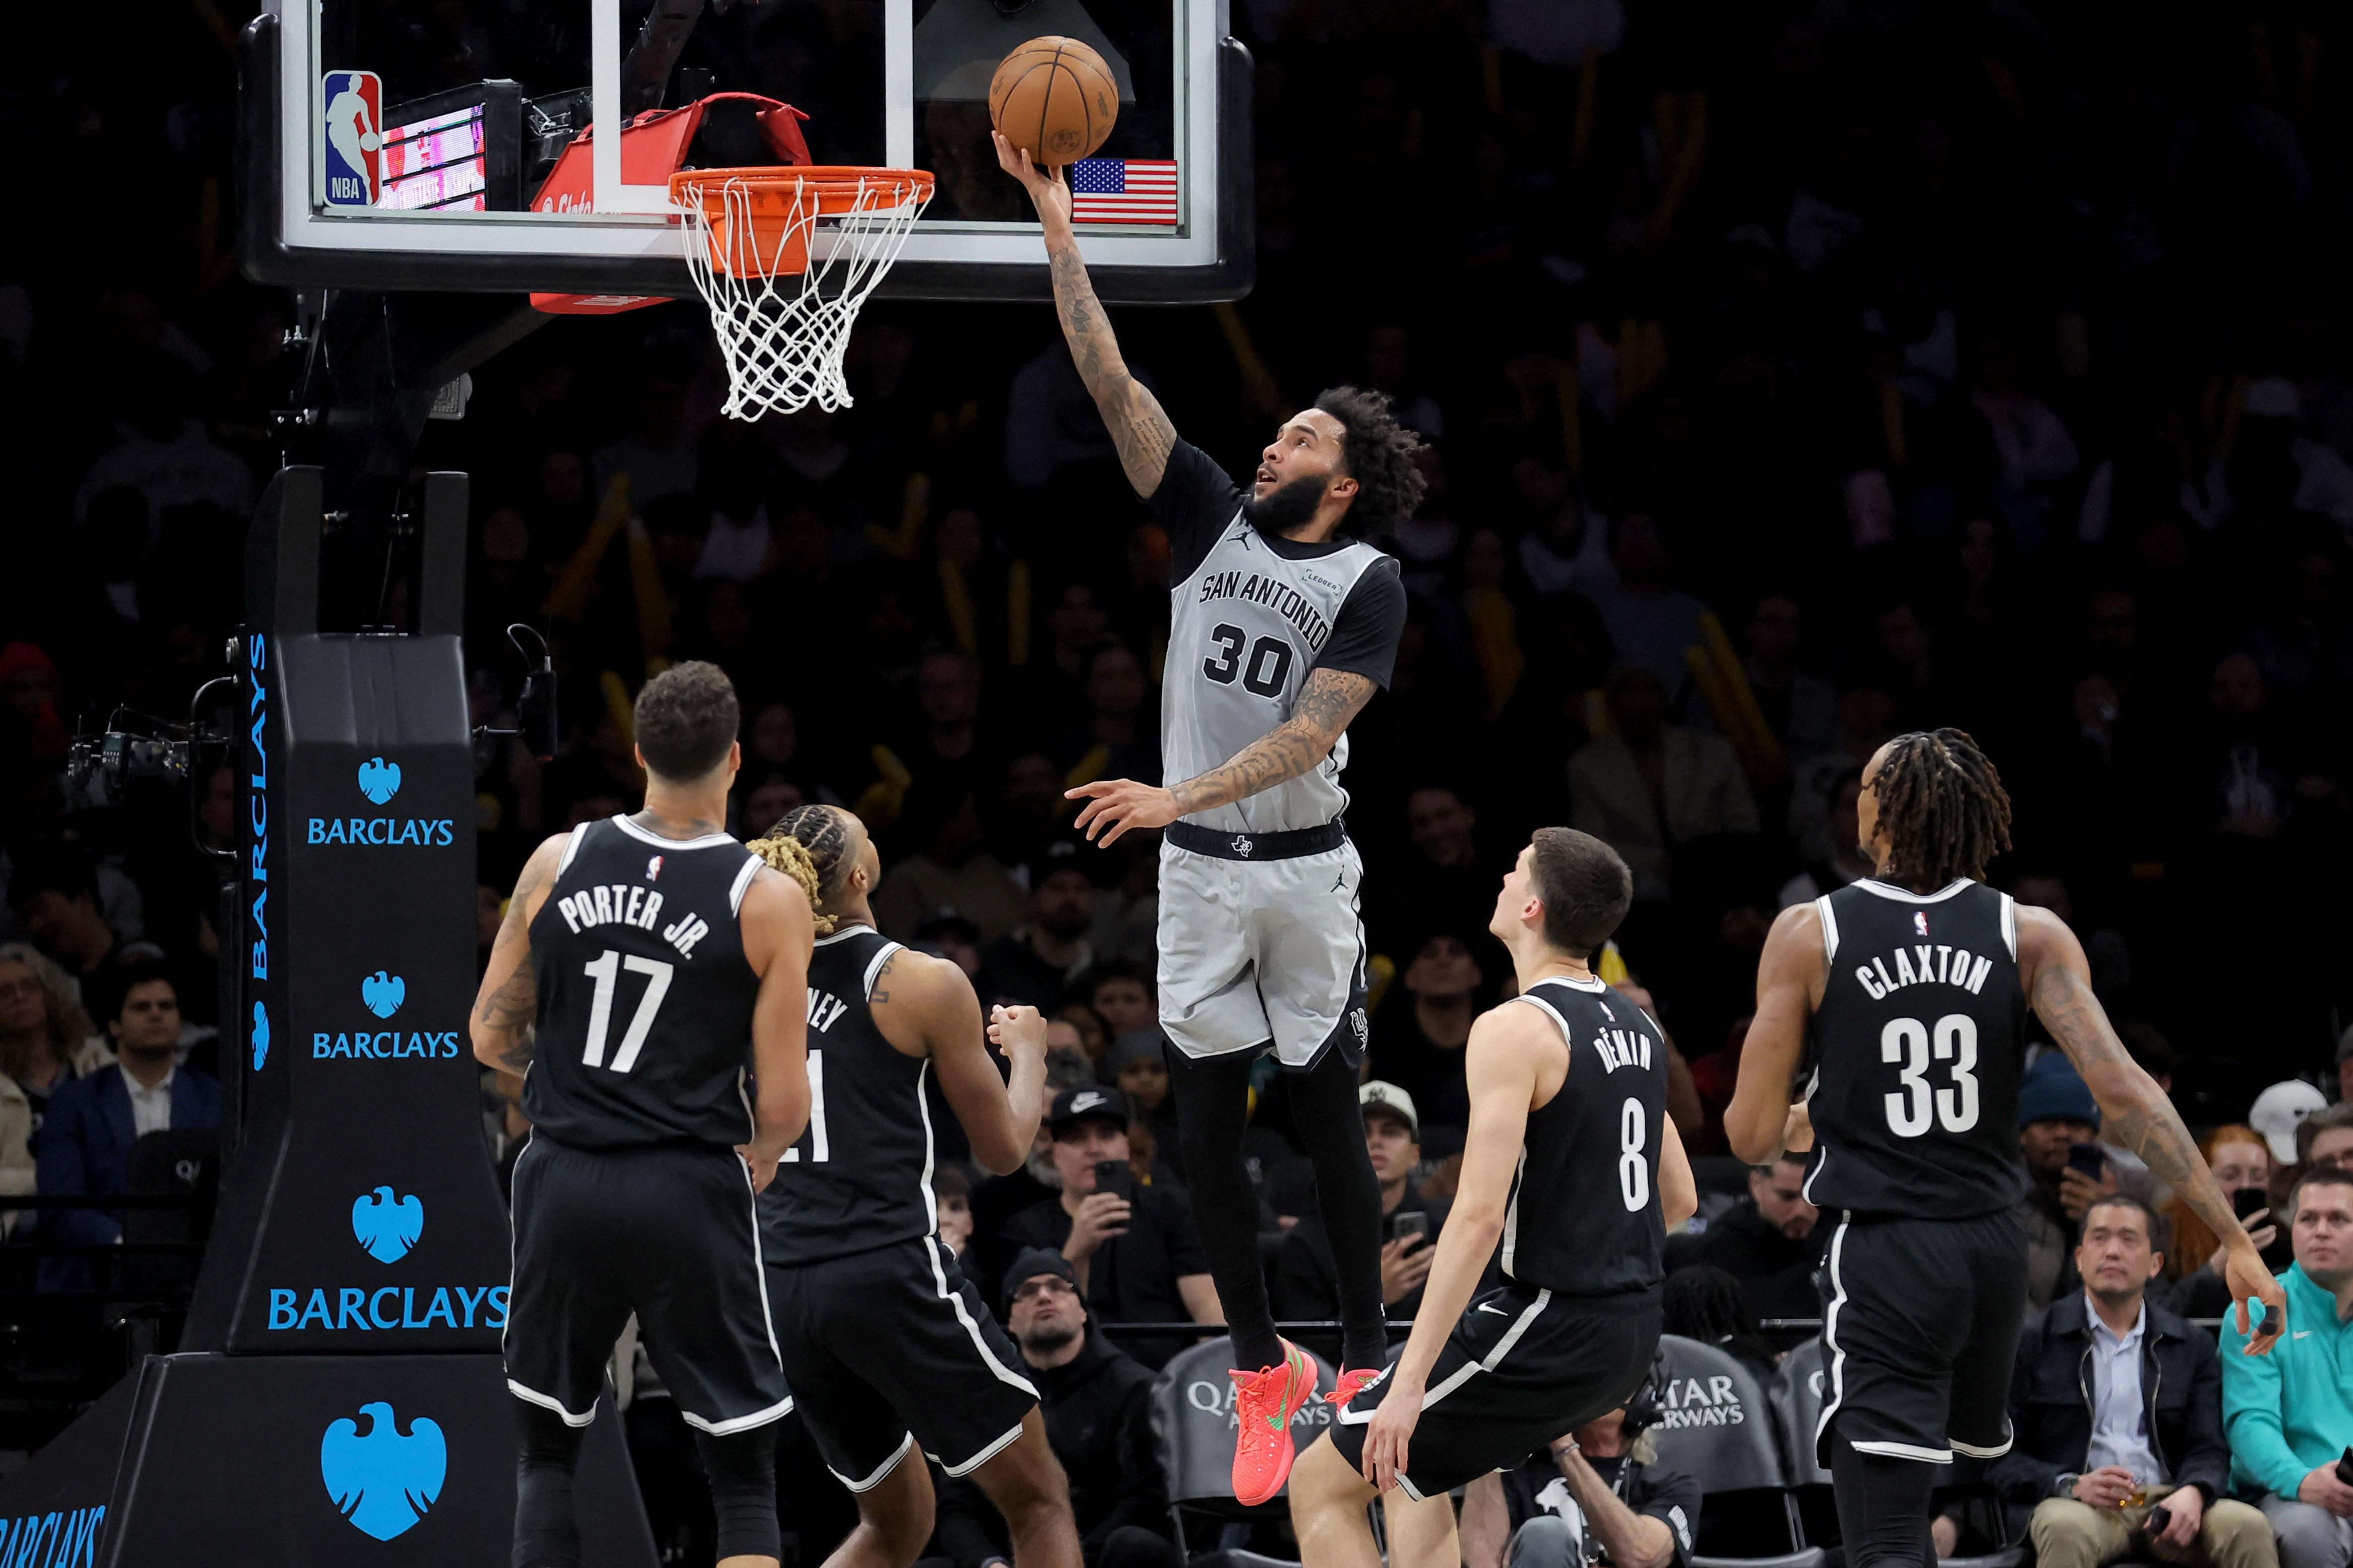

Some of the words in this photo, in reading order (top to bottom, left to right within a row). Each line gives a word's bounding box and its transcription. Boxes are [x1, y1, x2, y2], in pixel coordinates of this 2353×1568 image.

[332, 177, 360, 199] NBA
[1199, 570, 1244, 605] SAN
[1237, 572, 1331, 654] ANTONIO
[1308, 573, 1337, 590] LEDGER
[1201, 621, 1295, 700] 30
[250, 633, 268, 981] BARCLAYS
[307, 817, 453, 846] BARCLAYS
[557, 884, 665, 935] PORTER
[663, 912, 710, 961] JR.
[1855, 944, 1993, 1000] CLAXTON
[582, 949, 675, 1074] 17
[312, 1031, 459, 1059] BARCLAYS
[1880, 1013, 1980, 1138] 33
[778, 1049, 829, 1163] 1
[1619, 1096, 1651, 1213] 8
[267, 1286, 510, 1330] BARCLAYS
[1651, 1404, 1744, 1430] RWAYS
[1656, 1375, 1740, 1409] TAR
